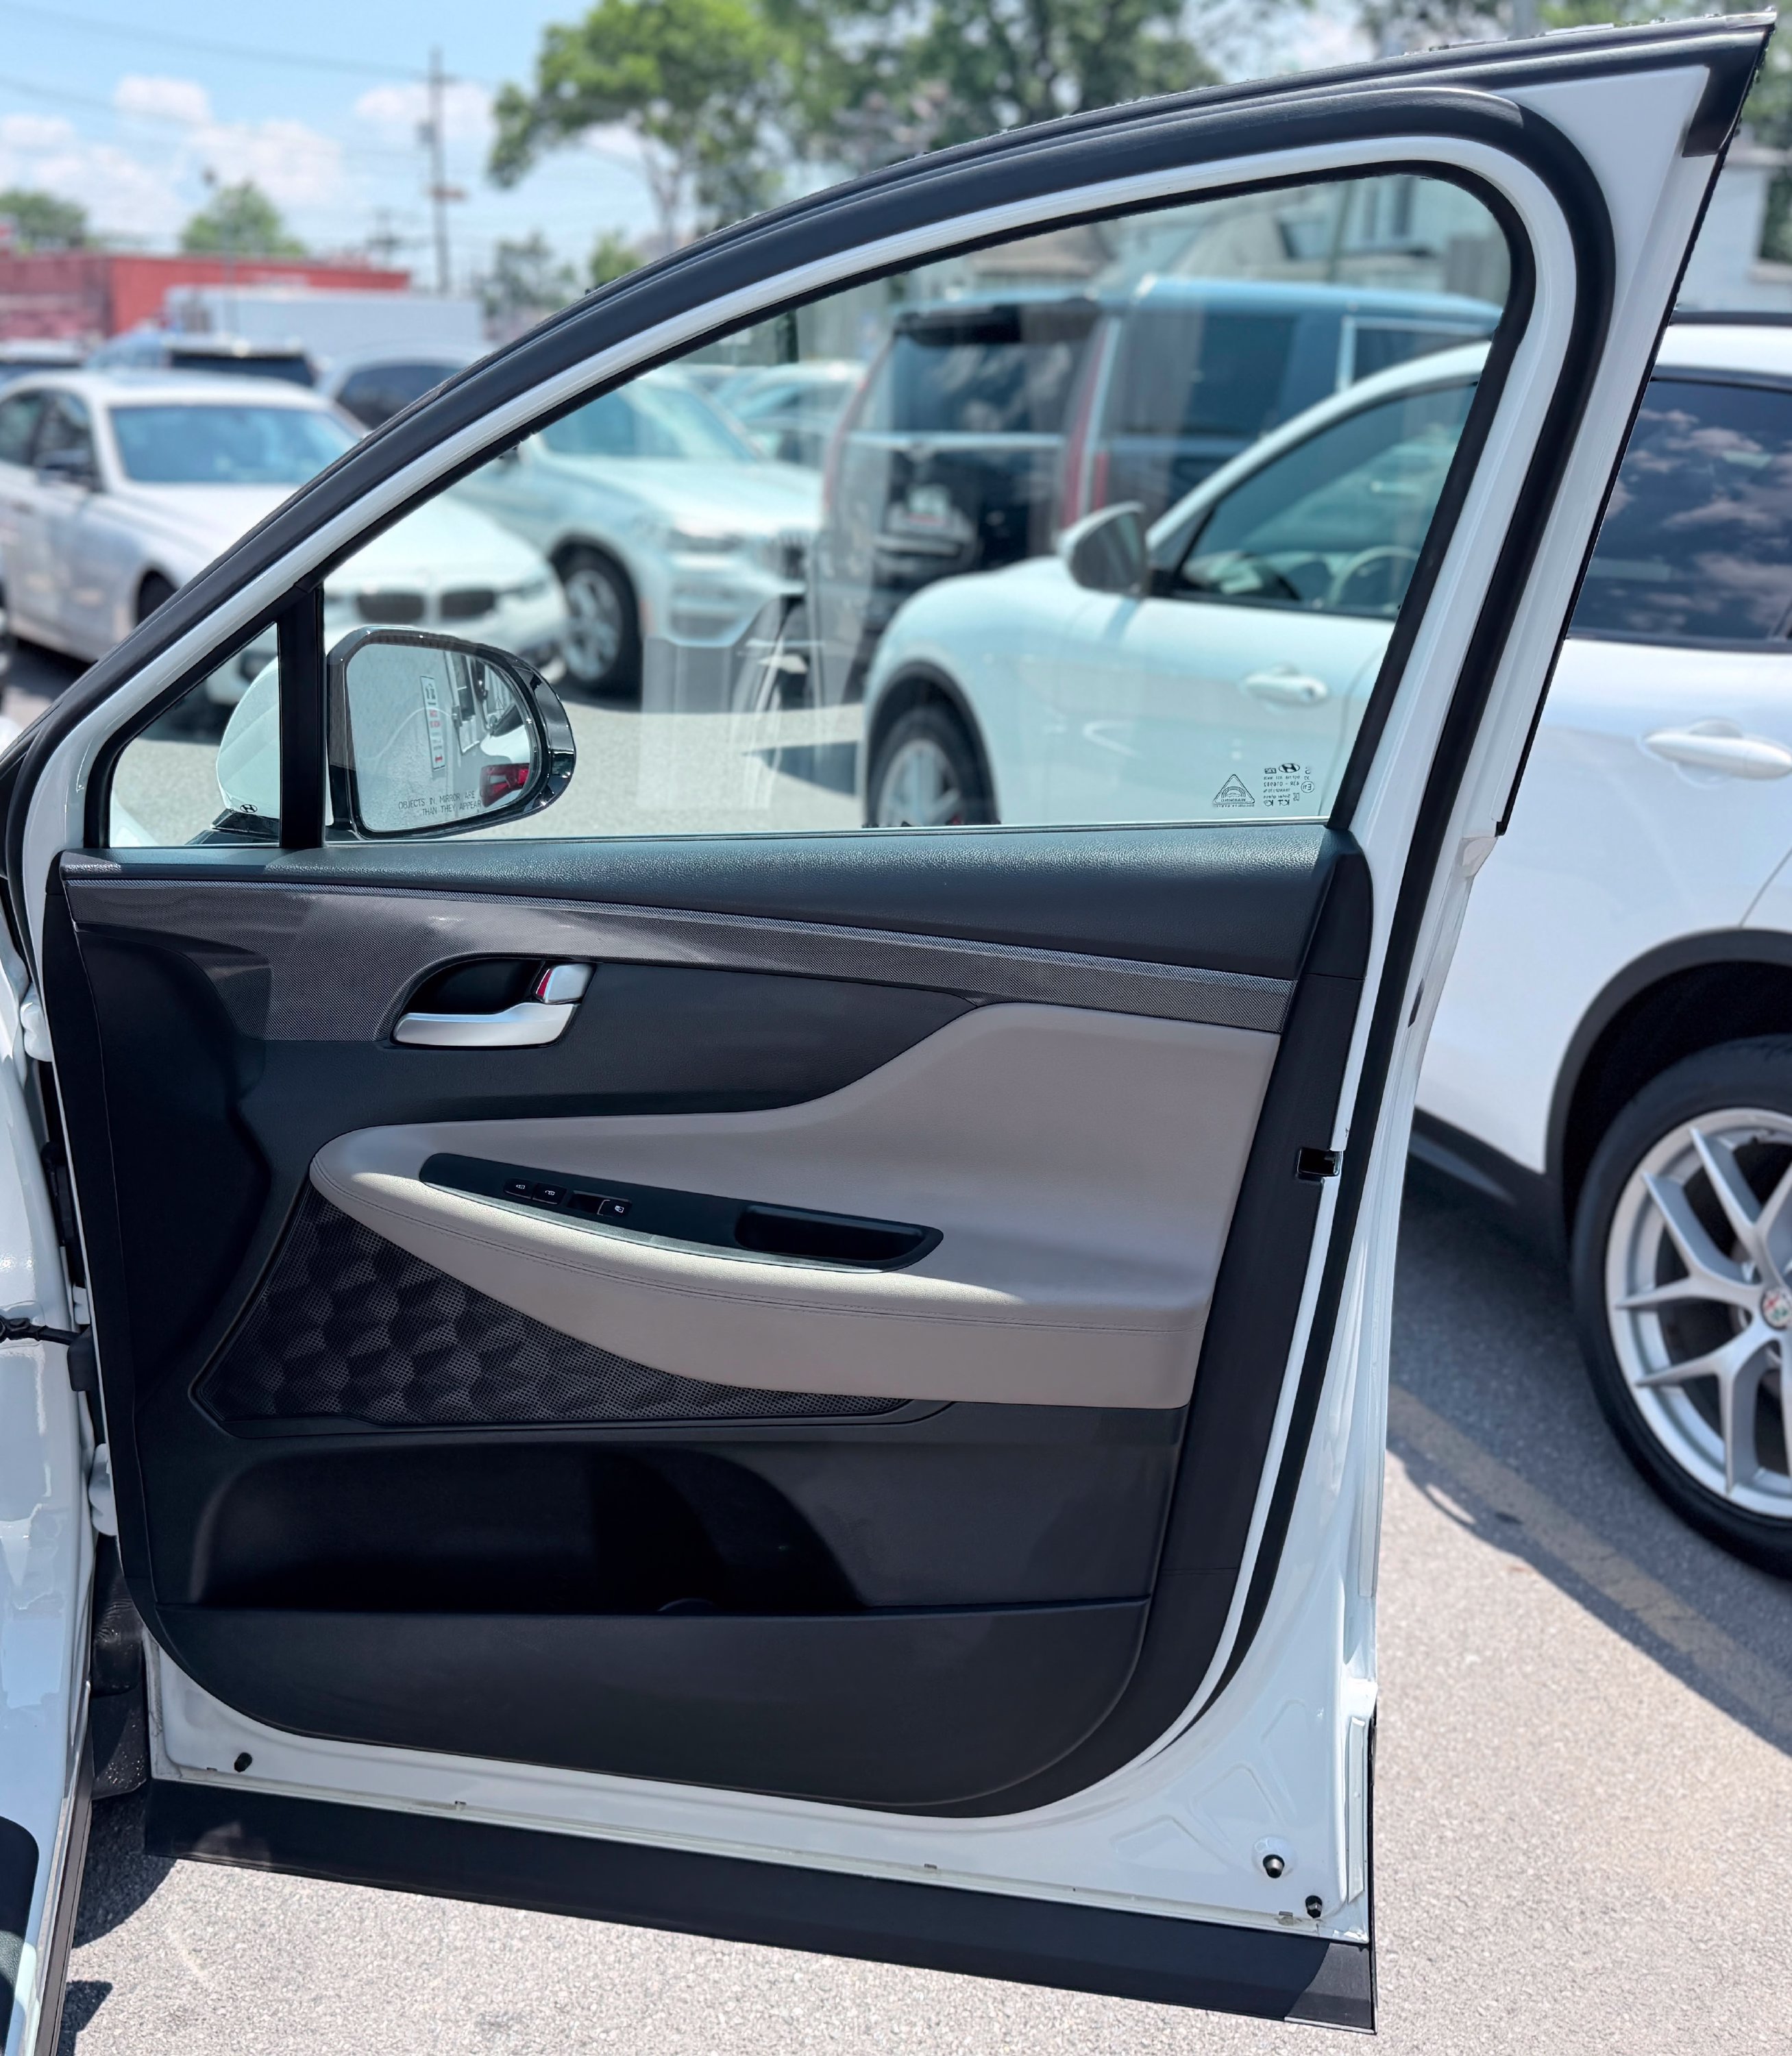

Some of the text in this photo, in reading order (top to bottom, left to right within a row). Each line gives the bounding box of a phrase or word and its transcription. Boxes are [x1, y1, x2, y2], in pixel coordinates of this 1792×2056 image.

[398, 798, 425, 809] OBJECTS
[429, 797, 435, 805] IN
[439, 793, 461, 803] MIRROR
[465, 791, 475, 799] ARE
[422, 800, 482, 816] THAN THEY APPEAR
